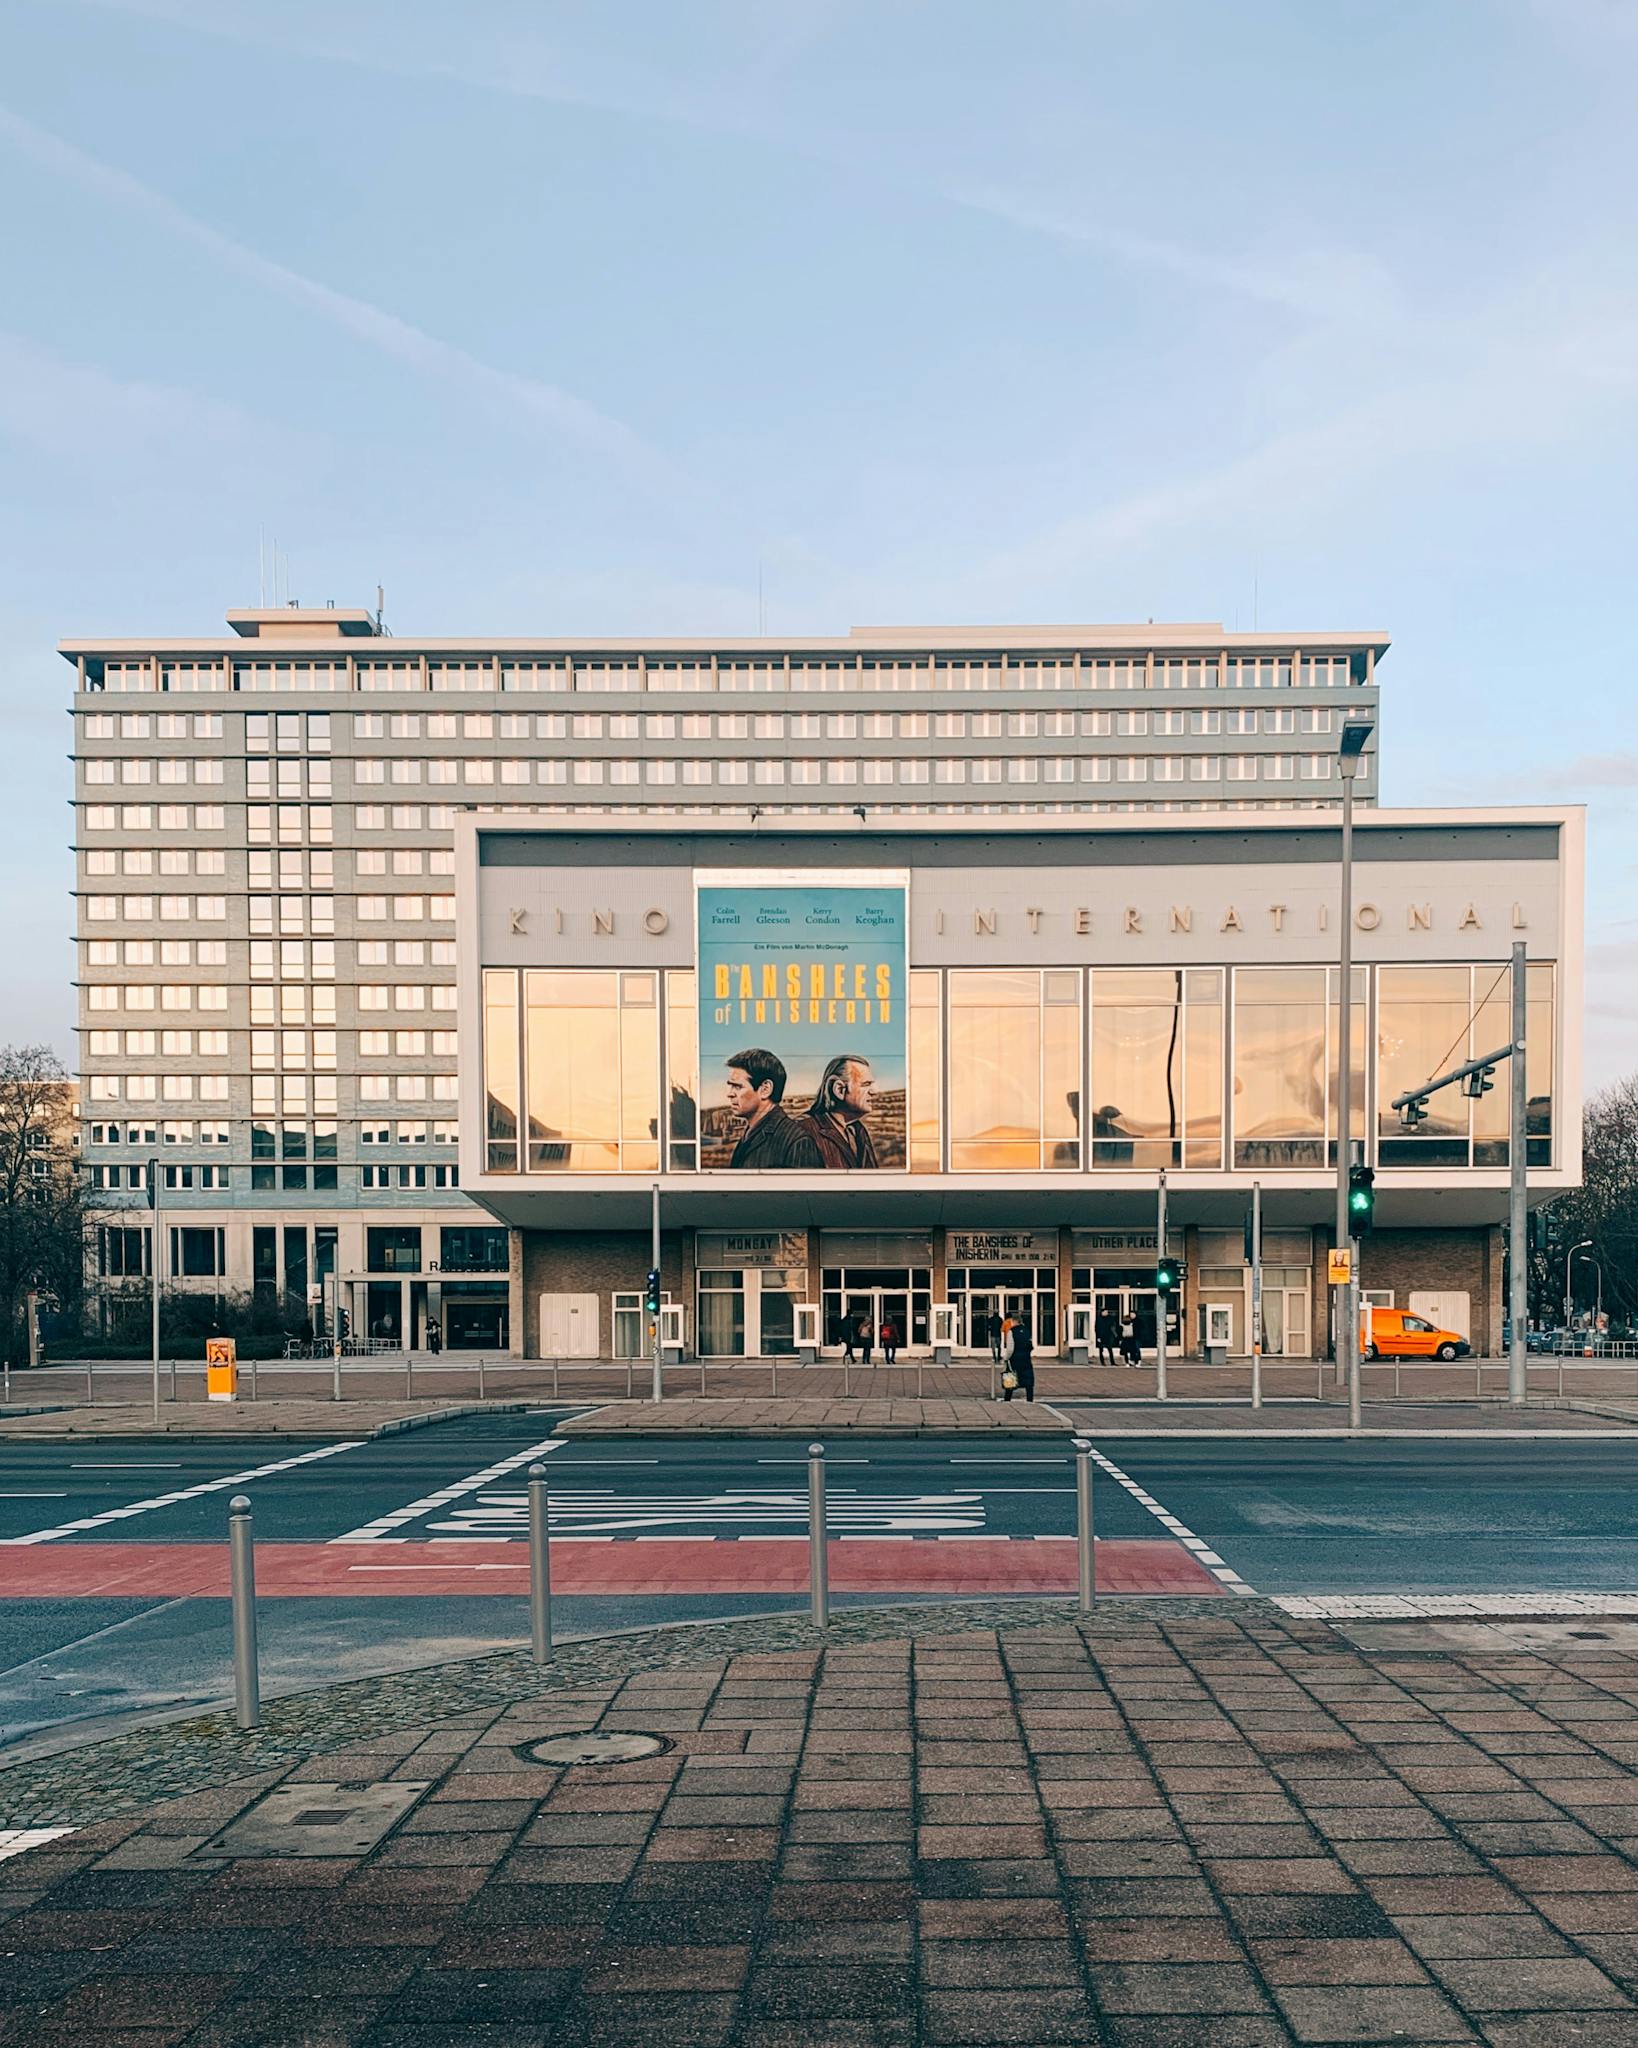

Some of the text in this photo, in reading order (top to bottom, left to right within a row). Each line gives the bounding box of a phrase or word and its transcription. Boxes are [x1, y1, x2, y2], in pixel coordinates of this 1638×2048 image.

[716, 907, 735, 915] Colin
[759, 907, 787, 915] Brendan
[813, 907, 832, 916] Kerry
[865, 907, 884, 916] Barry
[510, 902, 1528, 936] KINO INTERNATIONAL
[711, 916, 741, 925] Farrell
[756, 916, 791, 925] Gleeson
[805, 916, 841, 925] Condon
[855, 916, 895, 927] Keoghan
[714, 963, 891, 999] BANSHEES
[715, 1000, 891, 1025] of INISHERIN
[953, 1236, 1034, 1248] THE BANSHEES OF
[956, 1248, 1000, 1260] INISHERIN
